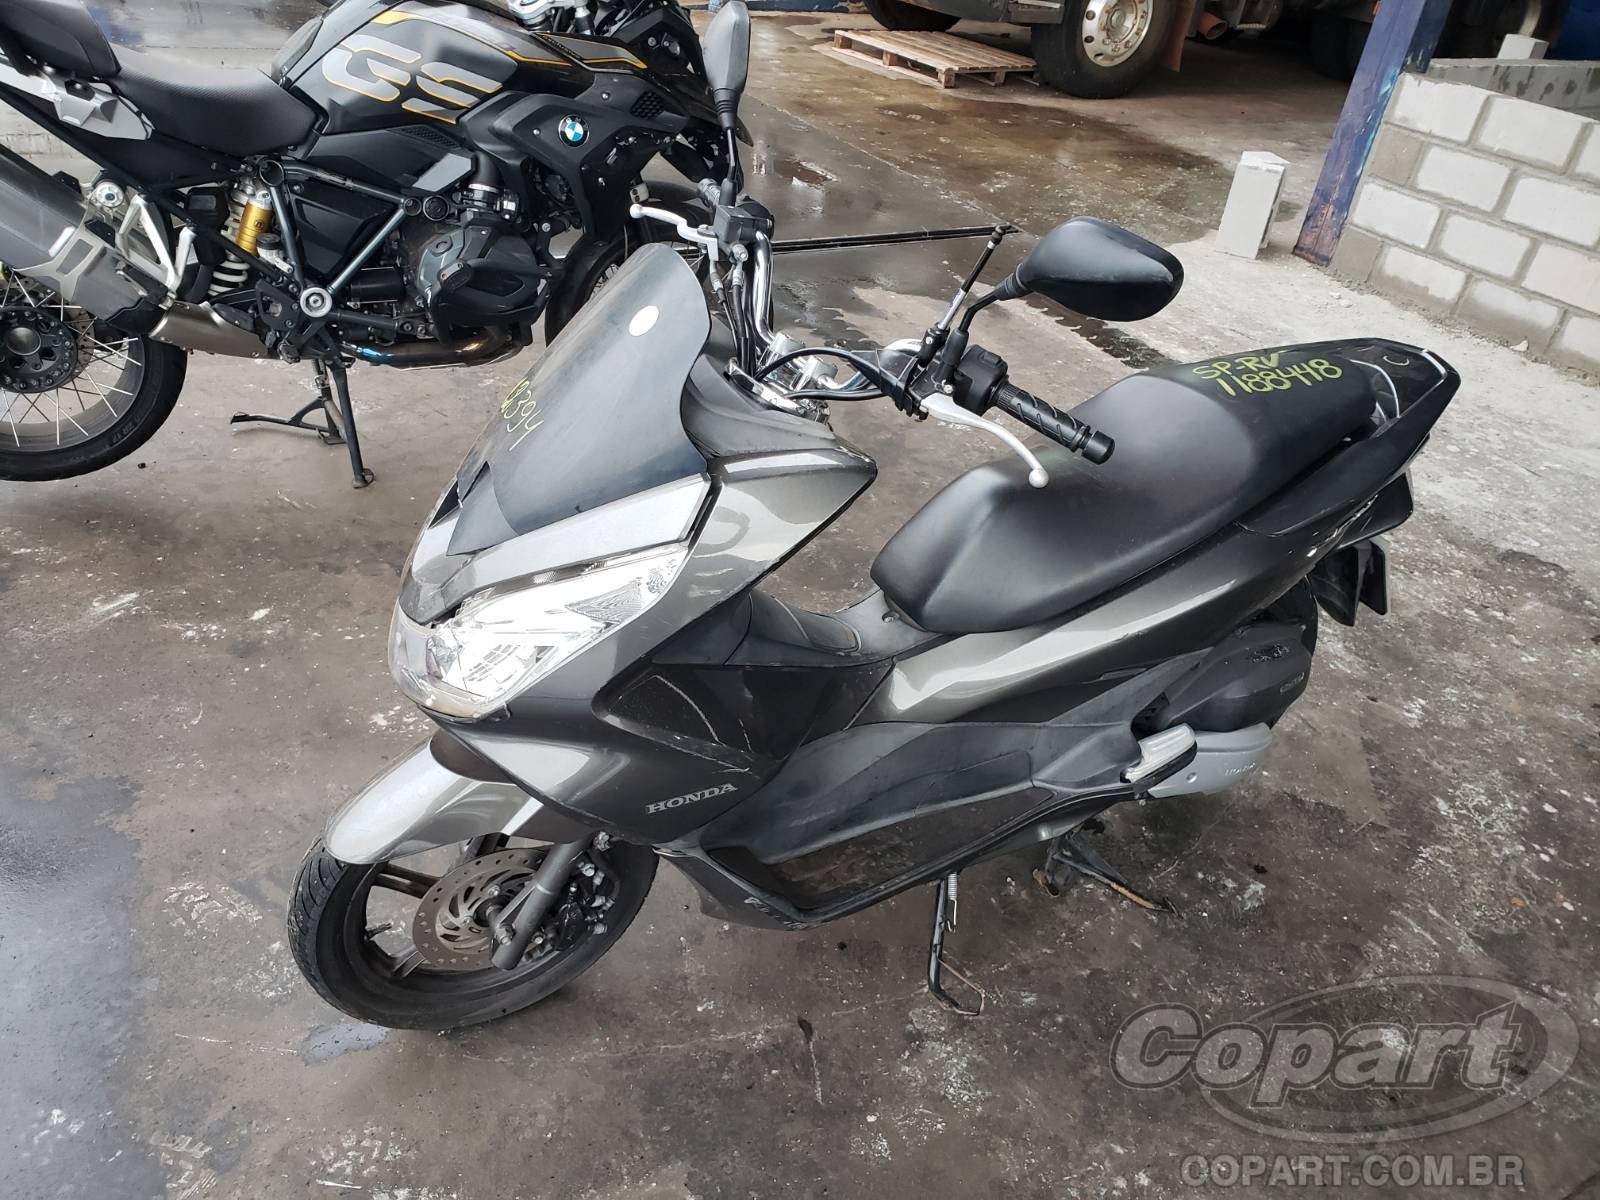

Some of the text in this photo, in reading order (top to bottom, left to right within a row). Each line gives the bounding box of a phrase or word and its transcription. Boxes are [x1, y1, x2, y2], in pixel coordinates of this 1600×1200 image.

[322, 33, 503, 125] GS
[1192, 352, 1280, 379] SP-RV
[645, 783, 739, 814] HONDA
